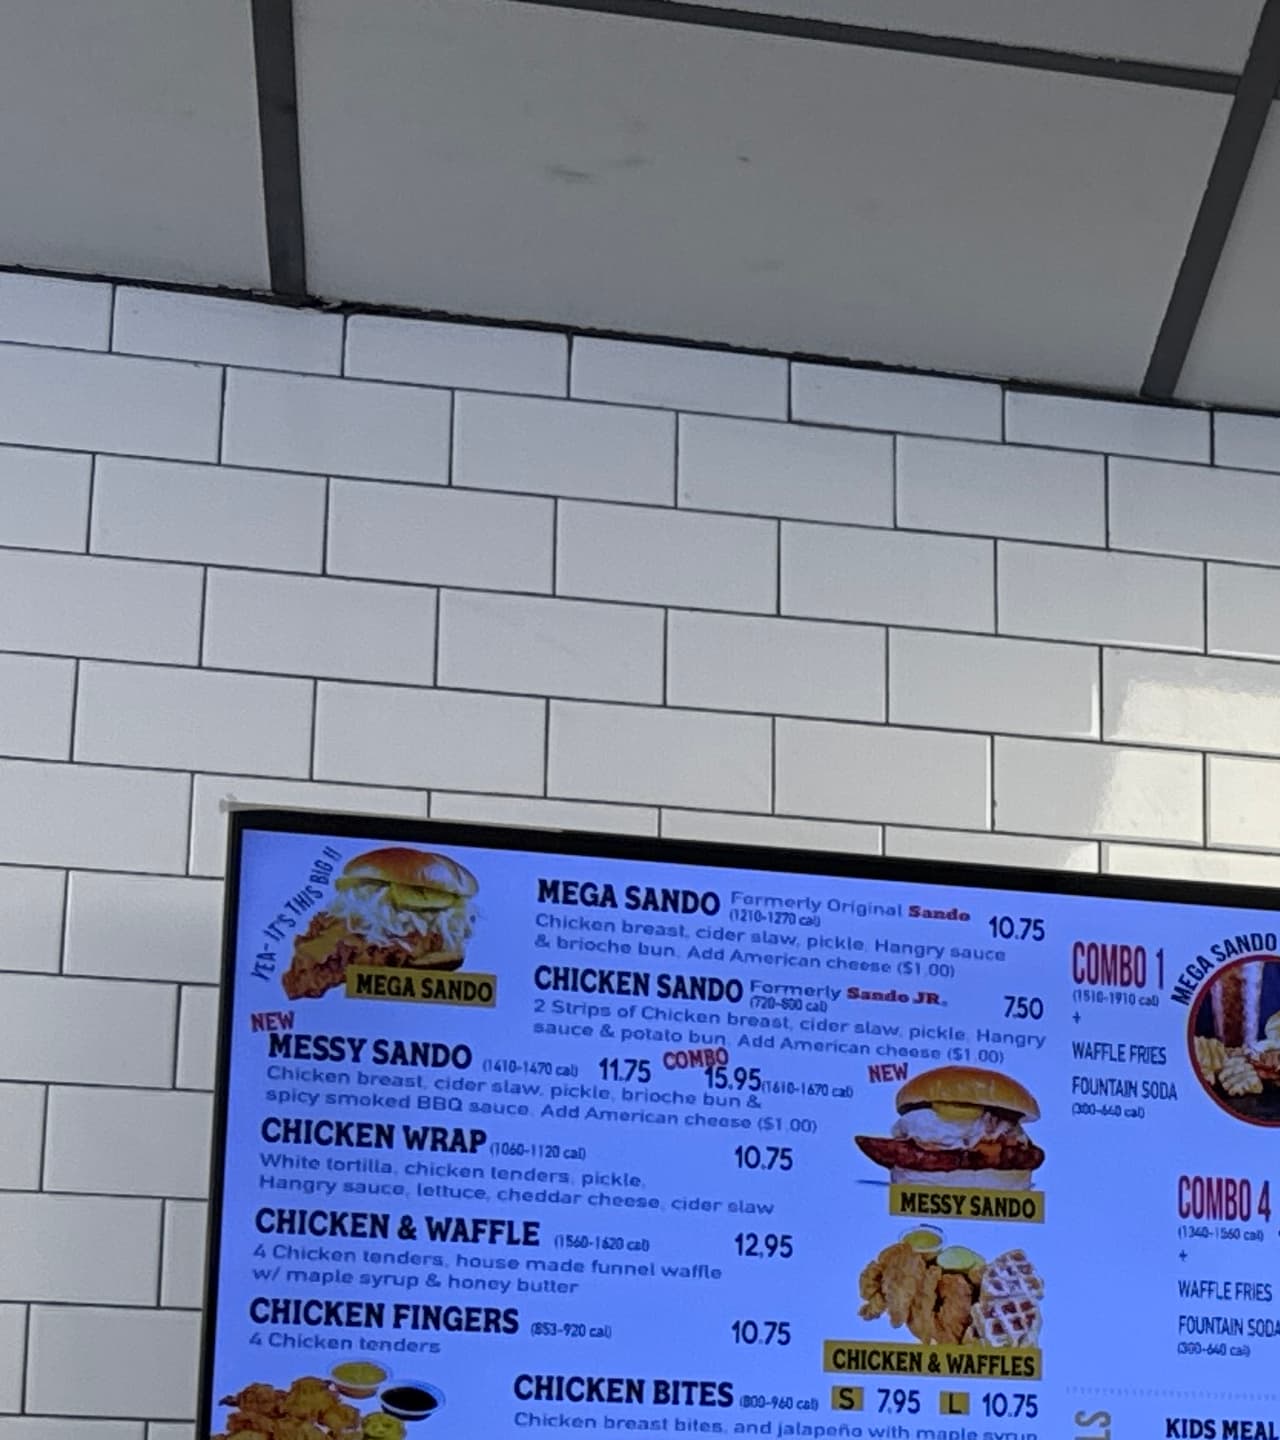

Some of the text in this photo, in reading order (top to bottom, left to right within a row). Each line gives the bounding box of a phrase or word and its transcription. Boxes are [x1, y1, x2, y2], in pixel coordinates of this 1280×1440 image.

[538, 879, 720, 916] MEGA SANDO
[732, 891, 970, 921] Formerly Original Sando
[989, 916, 1044, 941] 10.75
[1073, 941, 1163, 994] COMBO 1
[356, 973, 495, 1005] MEGA SANDO
[535, 965, 1043, 1020] CHICKEN SANDO 7.50
[251, 1011, 294, 1035] NEW
[269, 1033, 651, 1083] MESSY SANDO 11.75
[663, 1047, 728, 1071] COMBO
[1072, 1042, 1166, 1065] WAFFLE FRIES
[705, 1064, 763, 1091] 15.95
[868, 1063, 909, 1085] NEW
[1072, 1076, 1177, 1100] FOUNTAIN SODA
[262, 1117, 792, 1170] CHICKEN WRAP 10.75
[901, 1192, 1036, 1219] MESSY SANDO
[256, 1208, 539, 1246] CHICKEN & WAFFLE
[250, 1297, 790, 1345] CHICKEN FINGERS 10.75
[249, 1332, 440, 1353] 4 Chicken tenders
[833, 1348, 1035, 1377] CHICKEN & WAFFLES
[514, 1374, 1038, 1418] CHICKEN BITES S 7.95 L 10.75
[1166, 1418, 1216, 1440] KIDS
[1223, 1420, 1279, 1440] MEAL
